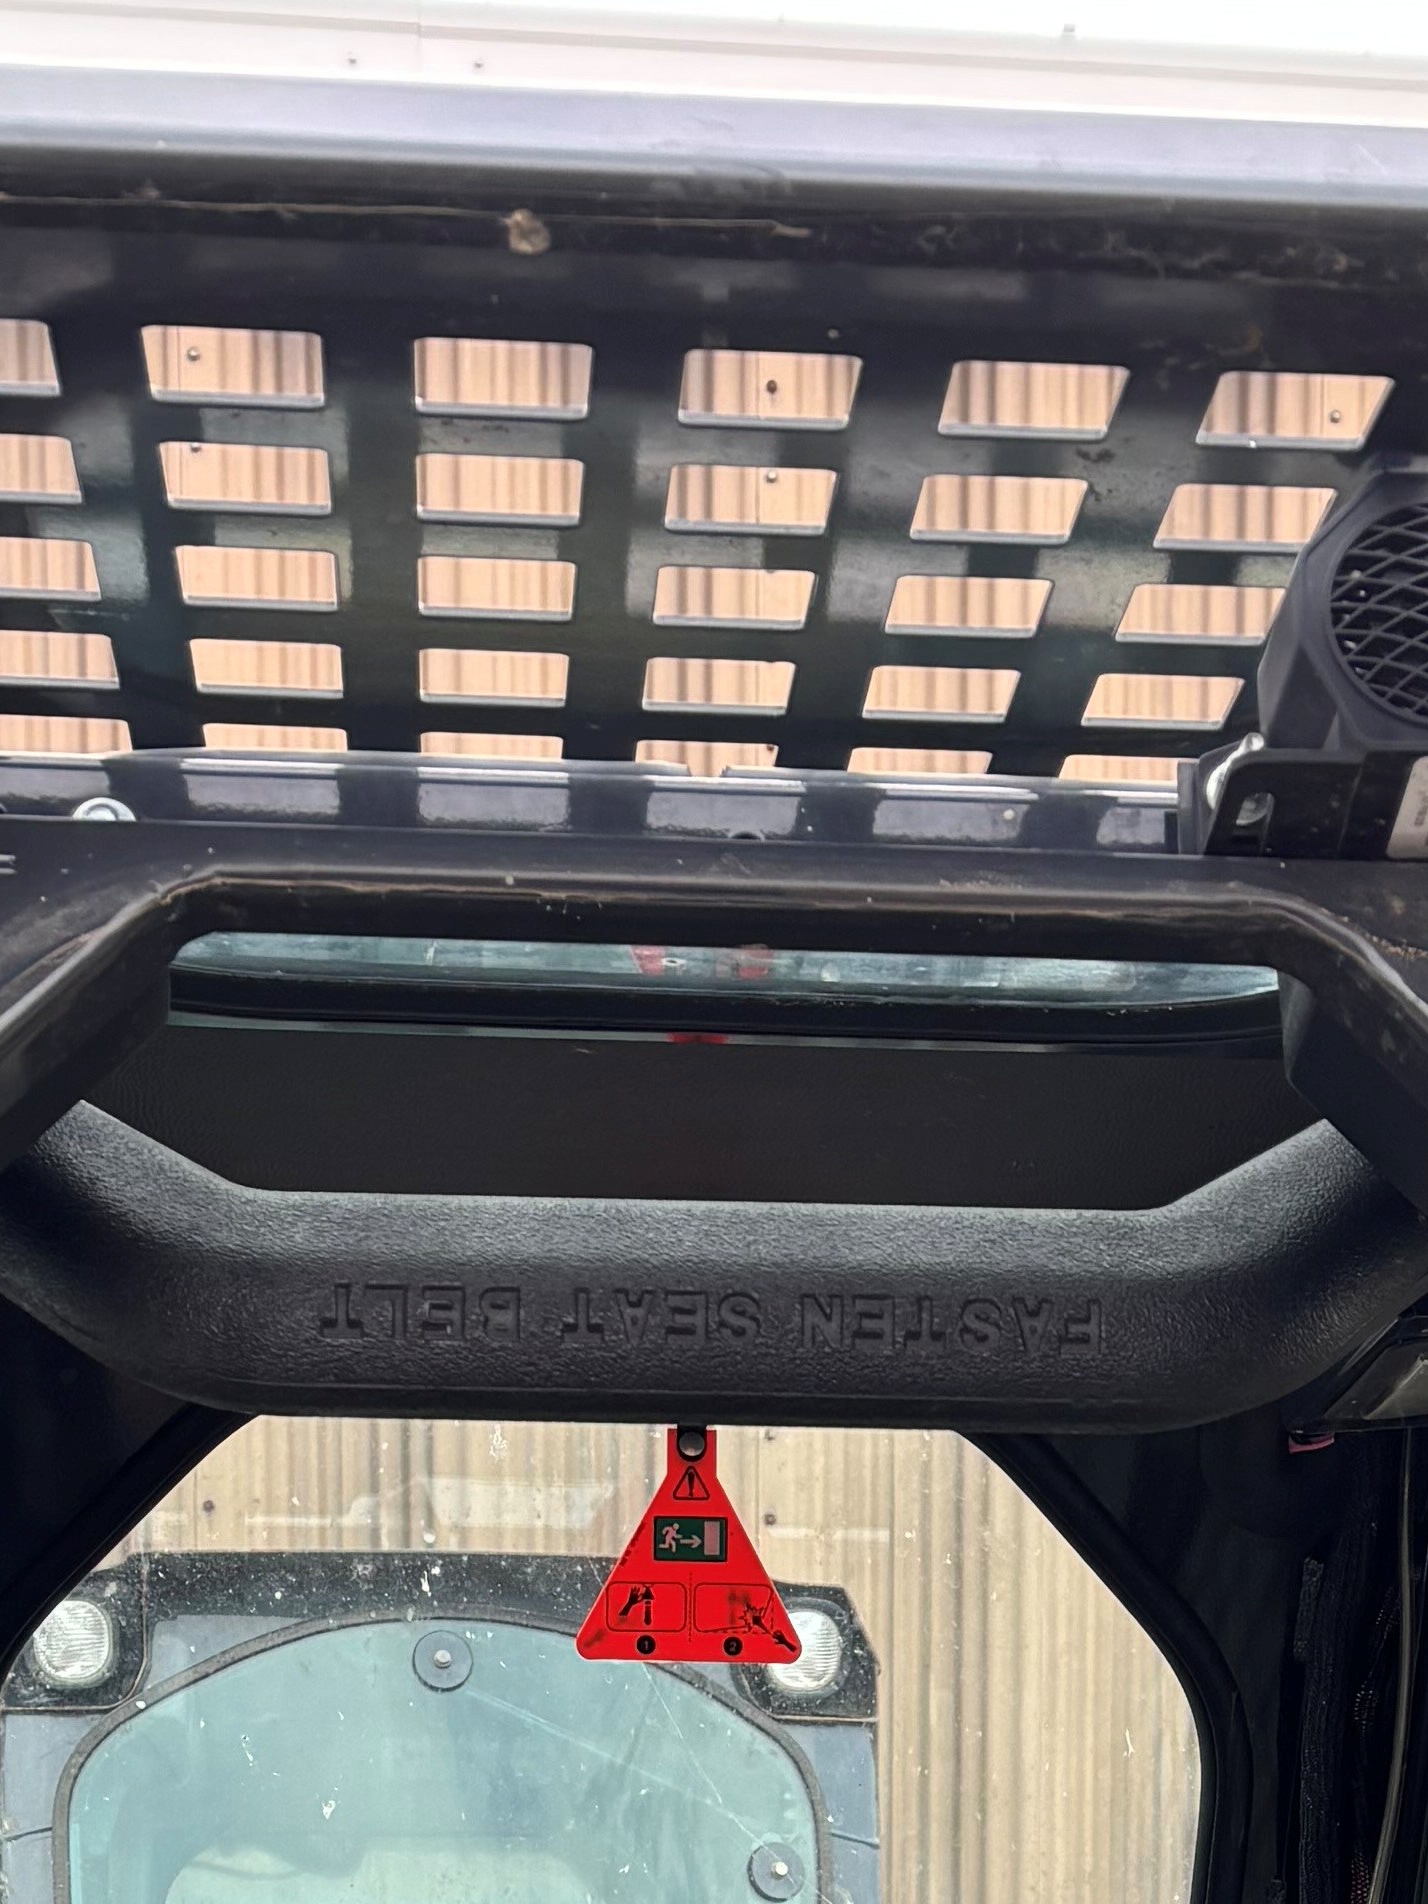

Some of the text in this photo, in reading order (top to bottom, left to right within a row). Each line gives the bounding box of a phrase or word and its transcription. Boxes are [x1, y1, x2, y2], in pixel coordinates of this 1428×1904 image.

[320, 1281, 1106, 1357] FASTEN SEAT BELT
